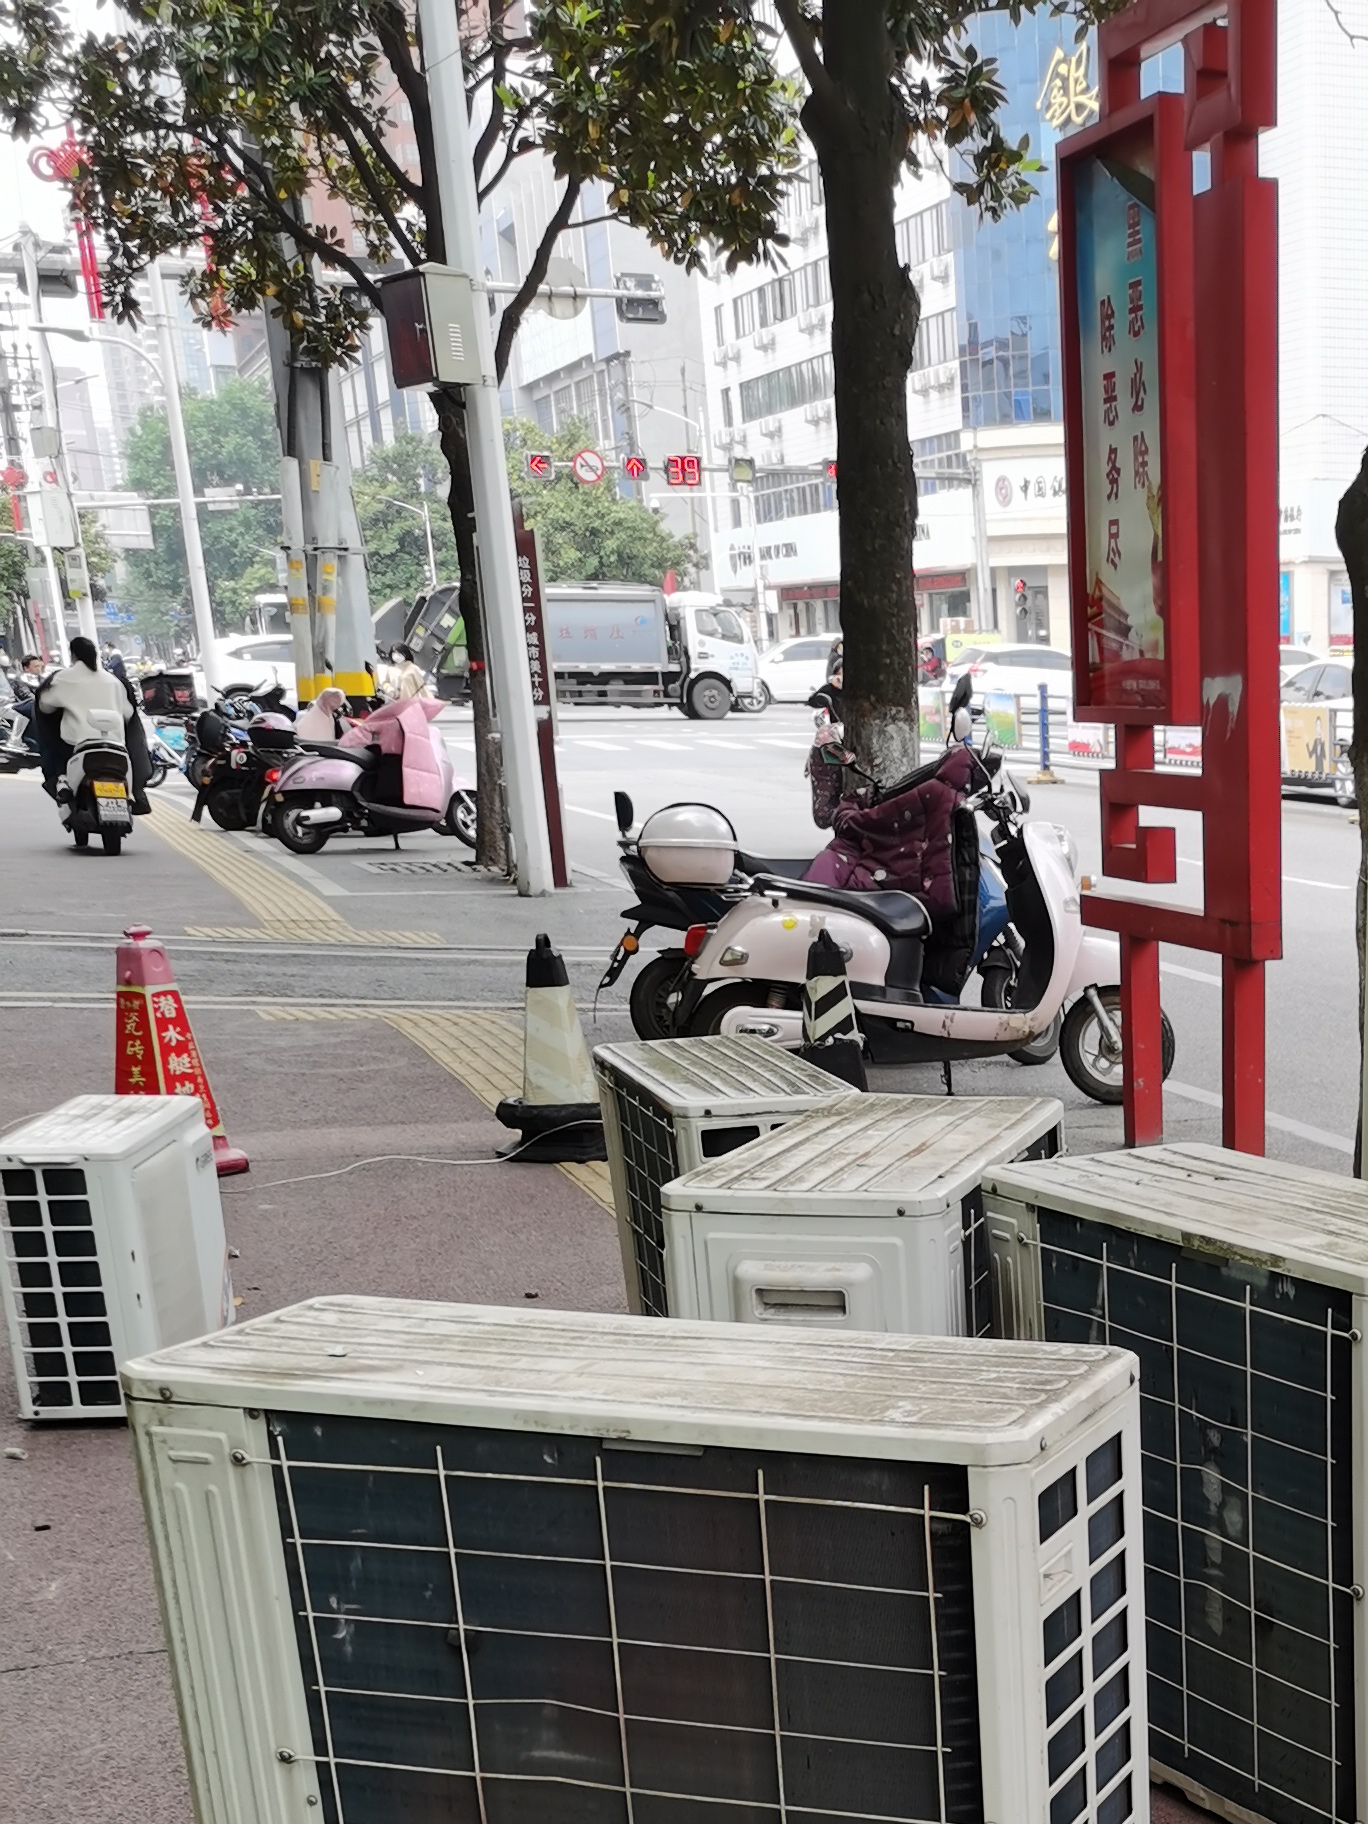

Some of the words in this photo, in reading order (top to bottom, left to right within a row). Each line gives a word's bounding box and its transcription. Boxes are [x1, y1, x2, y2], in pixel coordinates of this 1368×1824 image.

[1099, 294, 1122, 571] 除恶务尽
[668, 455, 700, 485] 39
[518, 555, 537, 626] 垃圾分一分
[527, 631, 544, 701] 城市美十分
[124, 1012, 146, 1094] 瓷砖美
